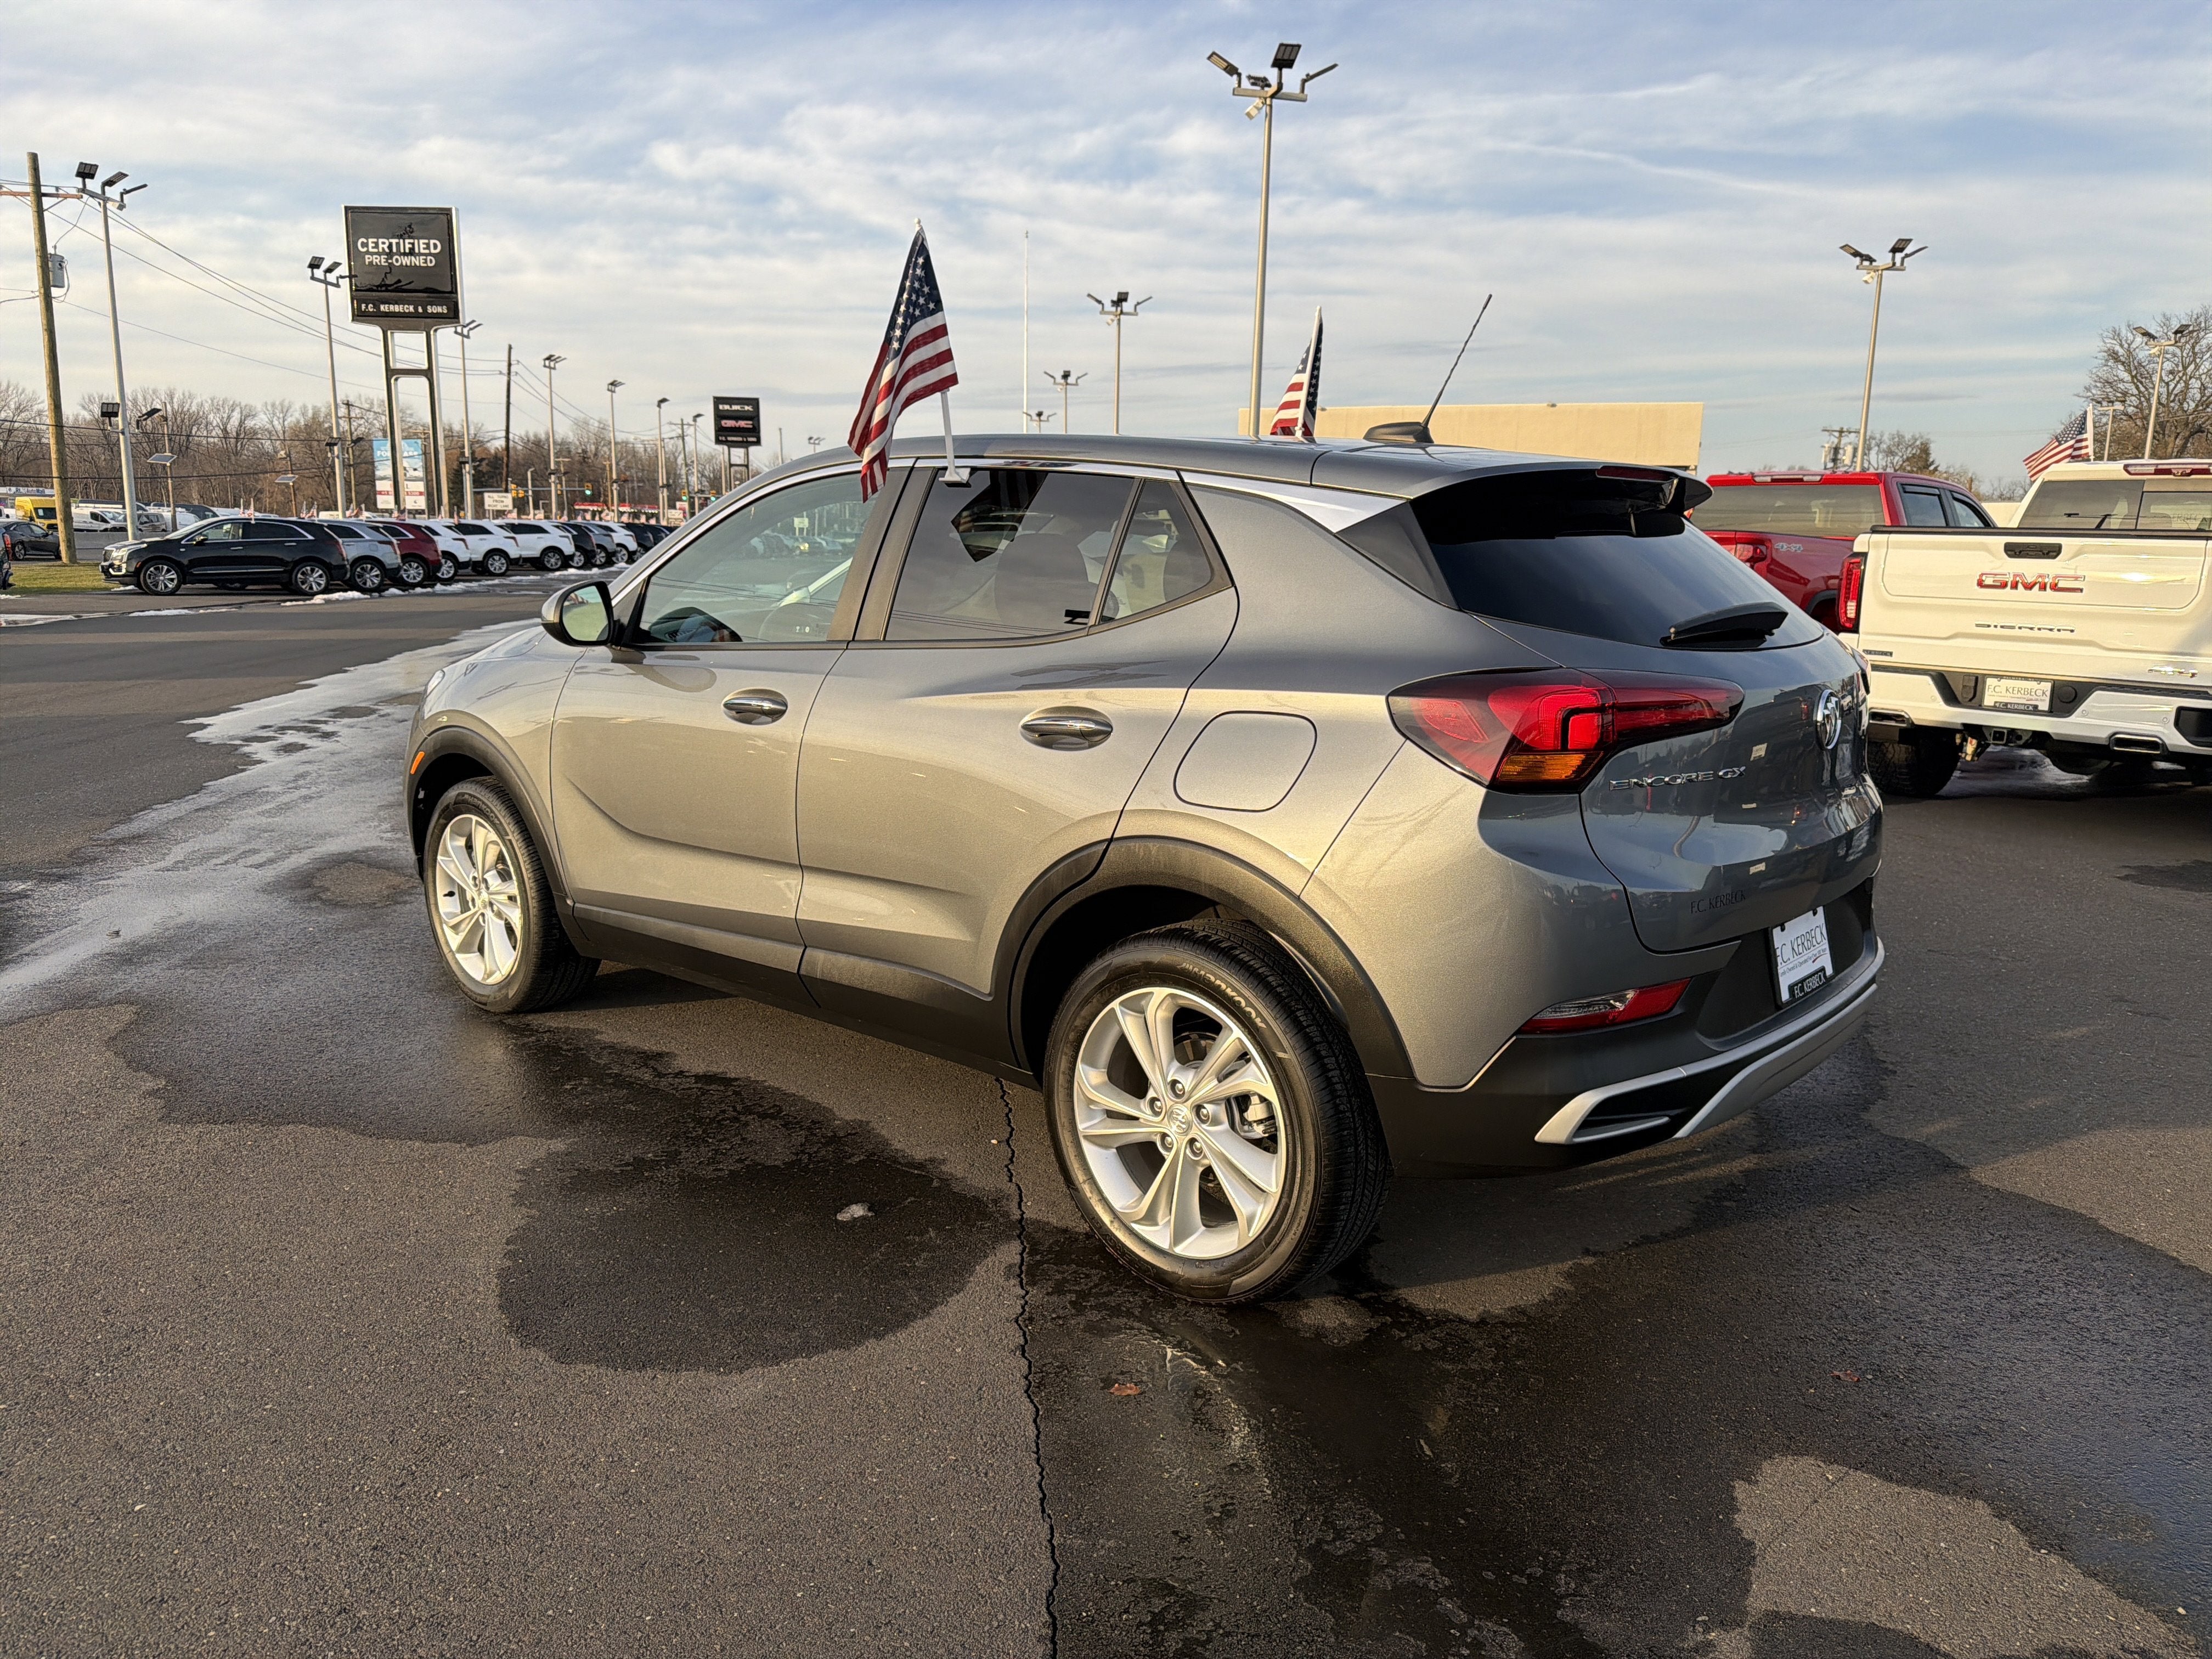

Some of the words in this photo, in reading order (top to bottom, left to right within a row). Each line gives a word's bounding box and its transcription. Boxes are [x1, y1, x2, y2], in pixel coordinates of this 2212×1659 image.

[357, 238, 442, 253] CERTIFIED
[365, 255, 436, 267] PRE-OWNED
[362, 303, 376, 312] F.C.
[380, 304, 415, 313] KERBECK
[427, 305, 448, 313] SONS
[720, 420, 753, 428] GMC
[1977, 572, 2085, 593] GMC
[1975, 621, 2075, 633] SIERRA
[1987, 684, 2002, 694] F.C.
[2005, 686, 2049, 697] KERBECK
[1610, 771, 1714, 791] ENCORE
[1717, 766, 1746, 779] GX
[1691, 899, 1707, 914] F.C.
[1709, 890, 1746, 910] KERBECK
[1790, 923, 1826, 958] KERBECK
[1794, 983, 1804, 999] F.C.
[1803, 971, 1826, 994] KERBECK
